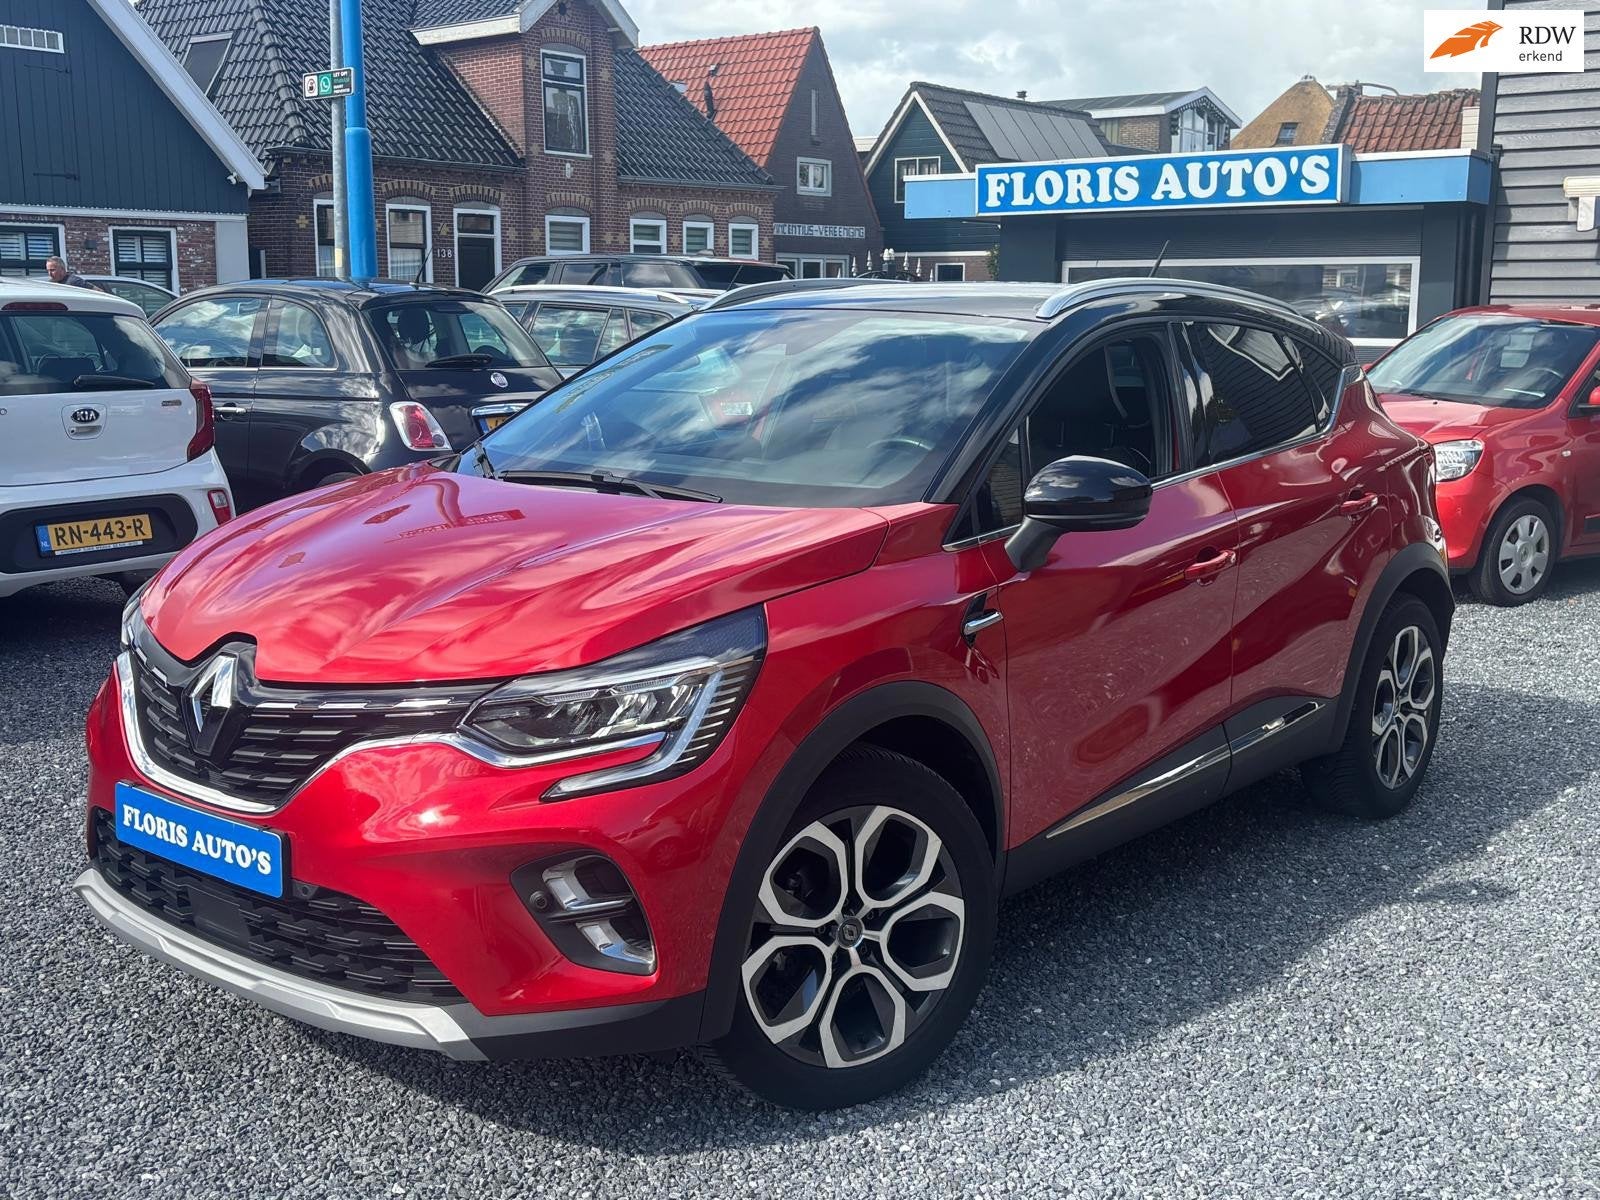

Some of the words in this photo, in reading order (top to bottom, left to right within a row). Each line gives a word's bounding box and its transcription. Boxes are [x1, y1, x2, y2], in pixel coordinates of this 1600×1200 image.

[985, 165, 1140, 208] FLORIS
[1150, 154, 1330, 201] AUTO'S
[437, 248, 453, 258] 138
[76, 410, 97, 421] KIA
[54, 518, 147, 547] RN-443-R
[122, 804, 188, 848] FLORIS
[191, 830, 272, 875] AUTO'S
